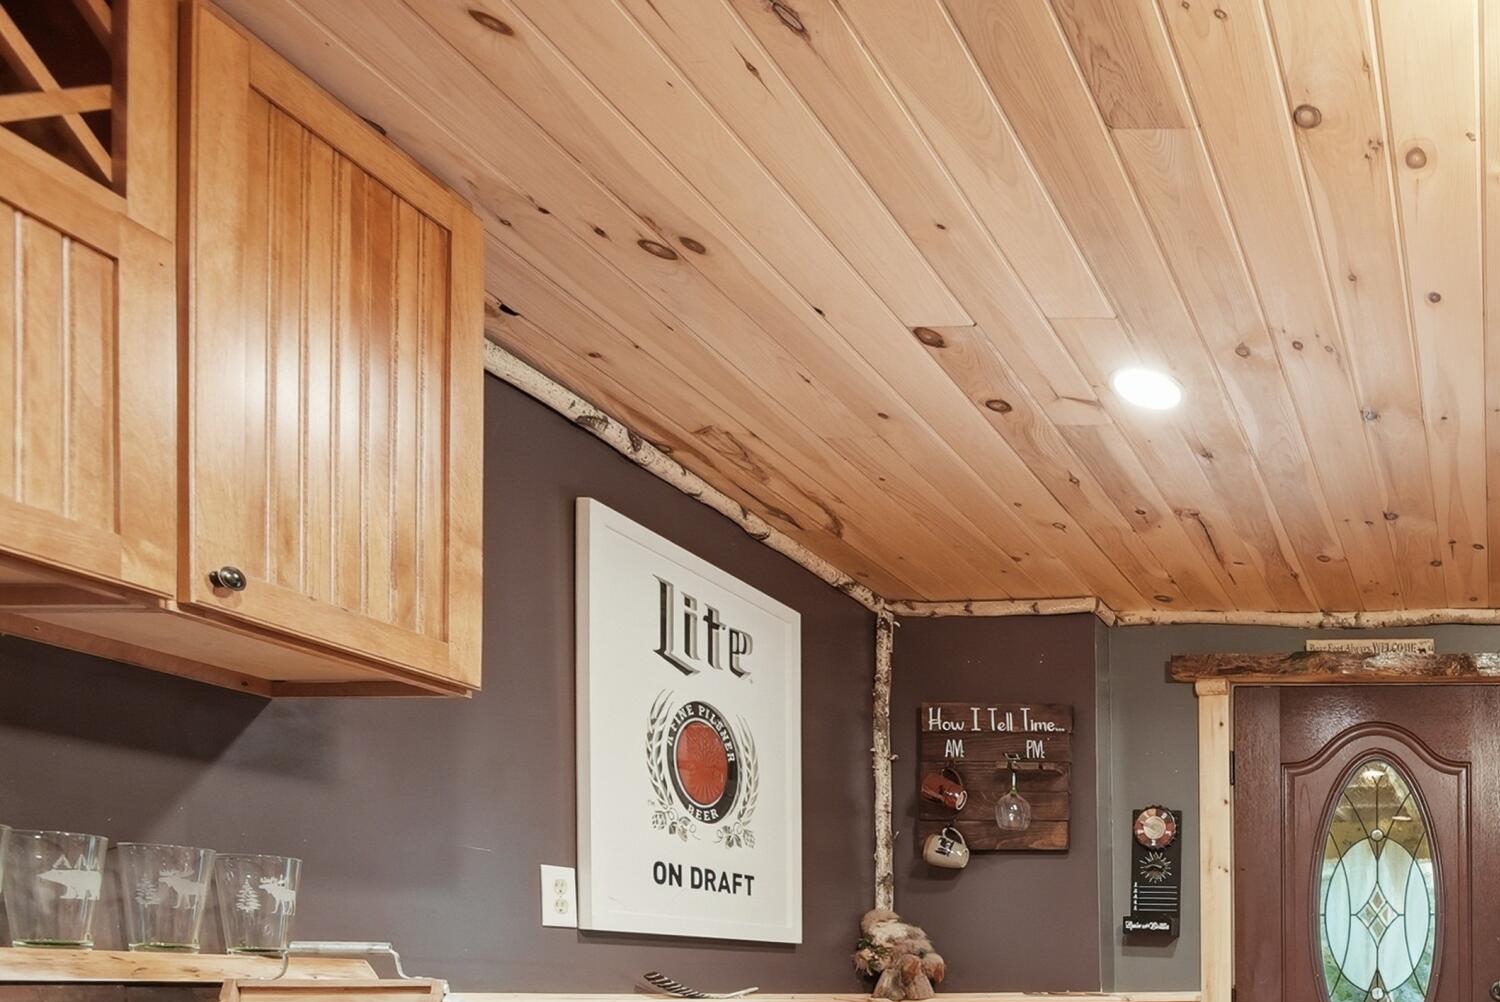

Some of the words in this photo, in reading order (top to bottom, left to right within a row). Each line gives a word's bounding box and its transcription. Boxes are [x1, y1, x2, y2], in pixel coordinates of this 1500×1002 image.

[652, 573, 754, 678] Lite
[671, 703, 695, 732] FINE
[698, 704, 736, 762] PILSNER
[928, 707, 965, 731] How
[970, 707, 982, 731] I
[987, 707, 1014, 732] Tell
[688, 803, 719, 821] BEER
[653, 861, 683, 888] ON
[690, 866, 755, 896] DRAFT
